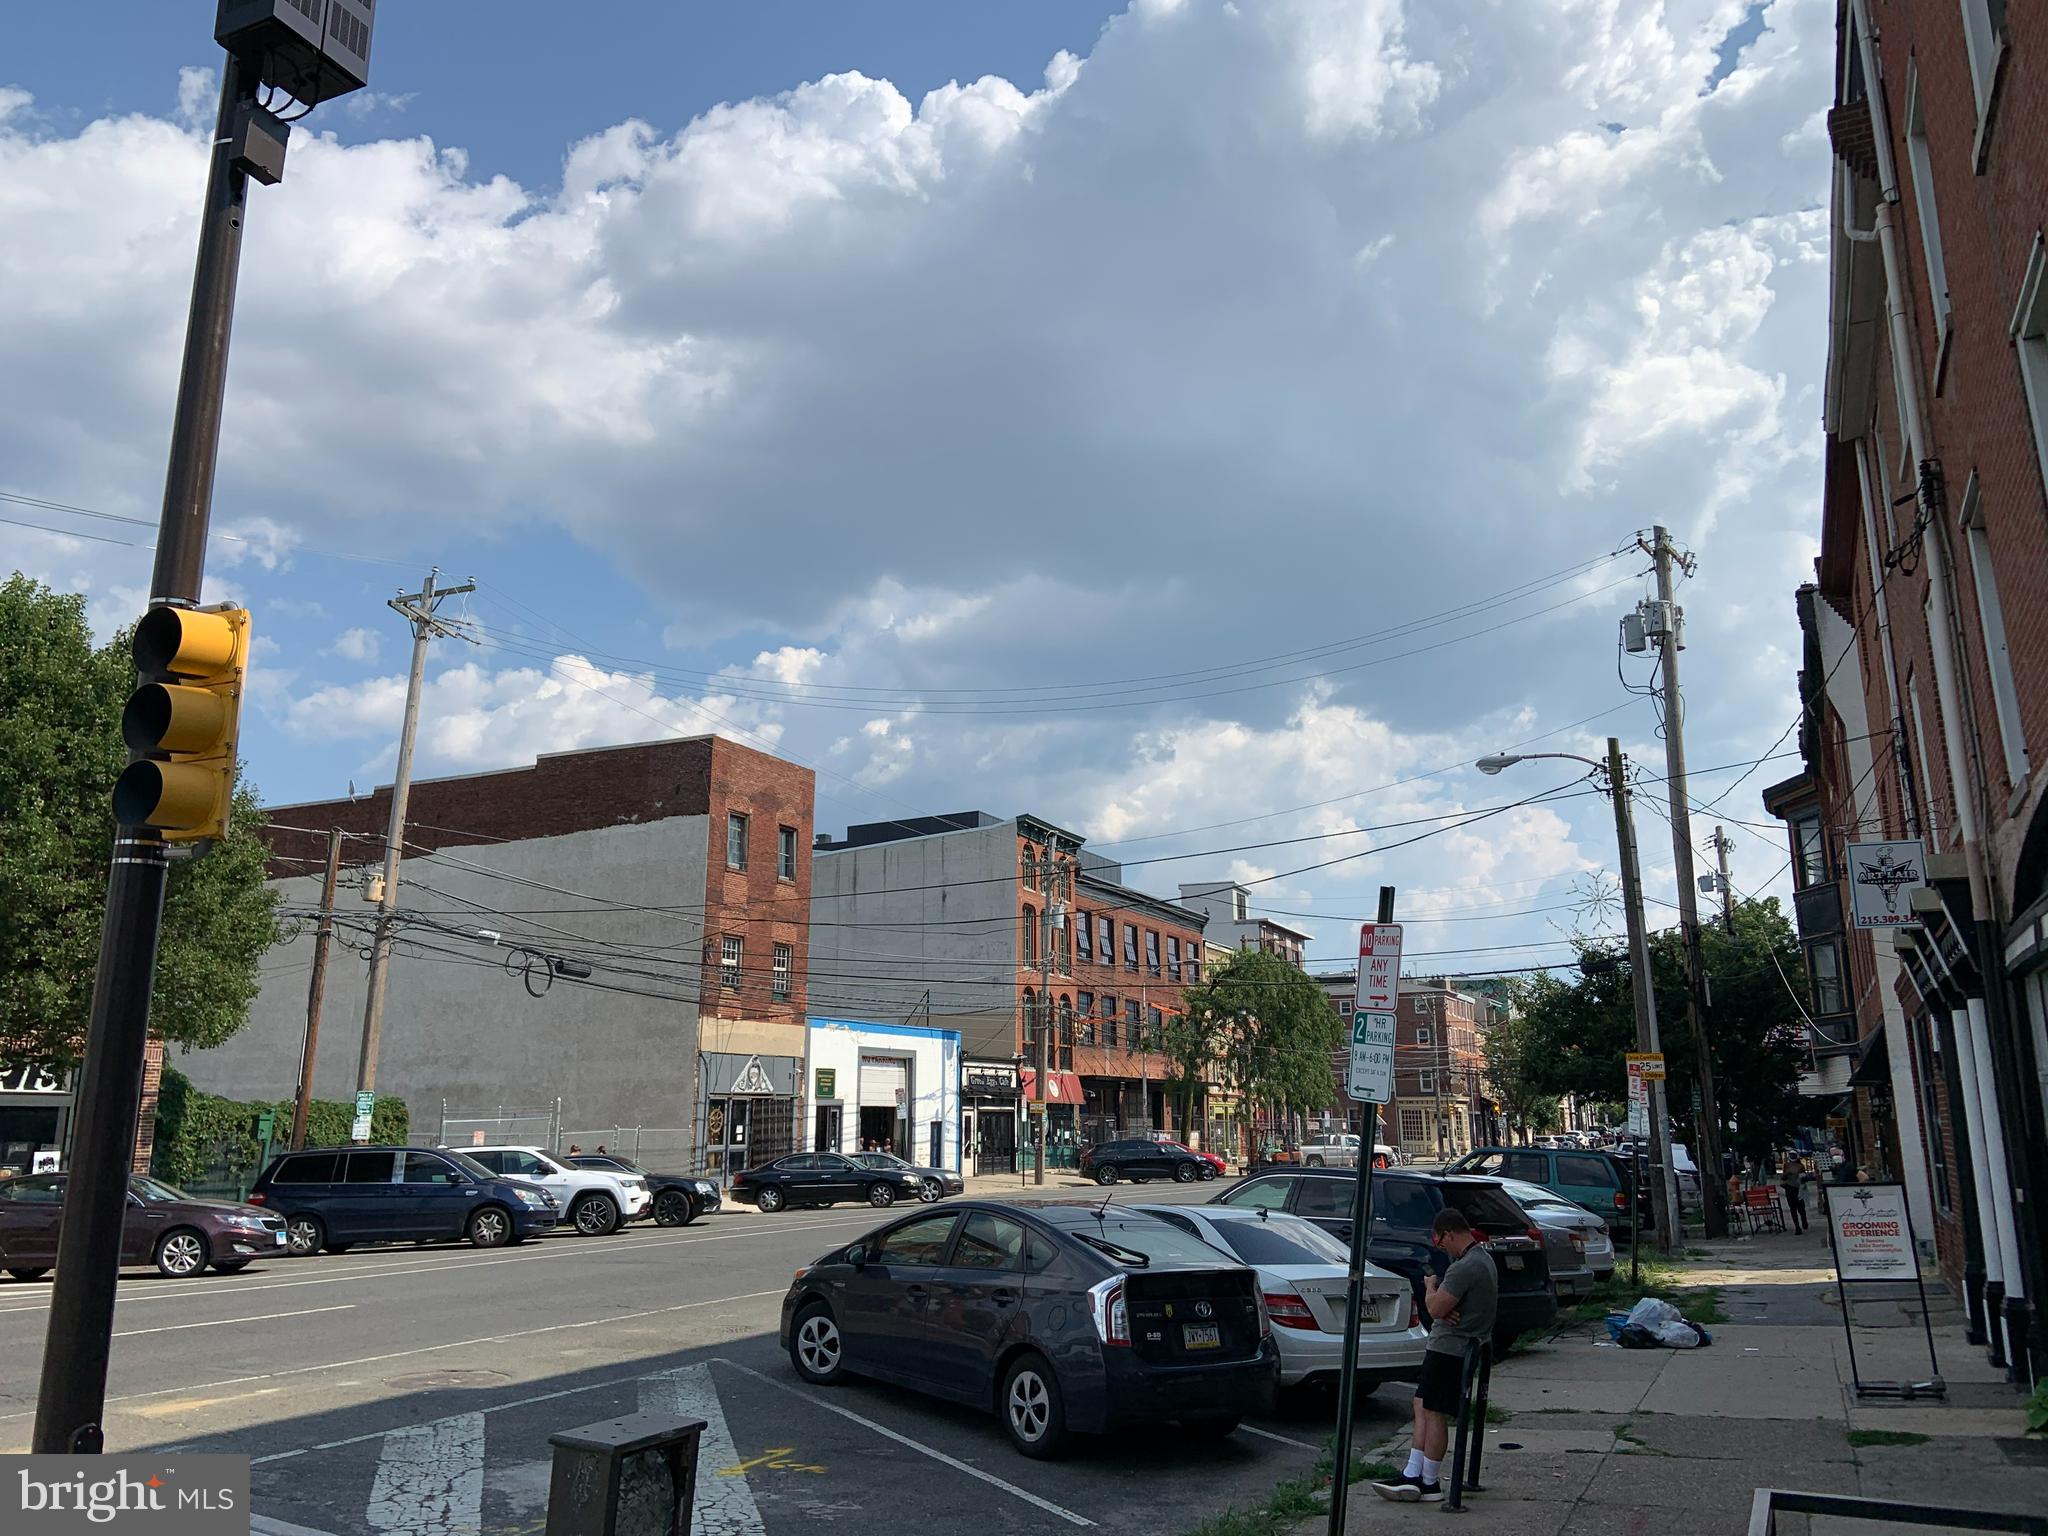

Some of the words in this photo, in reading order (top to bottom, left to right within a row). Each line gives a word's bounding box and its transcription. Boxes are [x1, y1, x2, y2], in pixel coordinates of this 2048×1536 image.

[1859, 871, 1884, 882] ART
[1886, 870, 1919, 879] LAIR
[1361, 933, 1373, 949] NO
[1374, 935, 1400, 946] PARKING
[1370, 959, 1388, 972] ANY
[1369, 974, 1388, 988] TIME
[1356, 1017, 1365, 1039] 2
[1375, 1017, 1387, 1029] HR
[1366, 1031, 1392, 1044] PARKING
[1382, 1053, 1390, 1065] PM
[1640, 1062, 1651, 1071] 25
